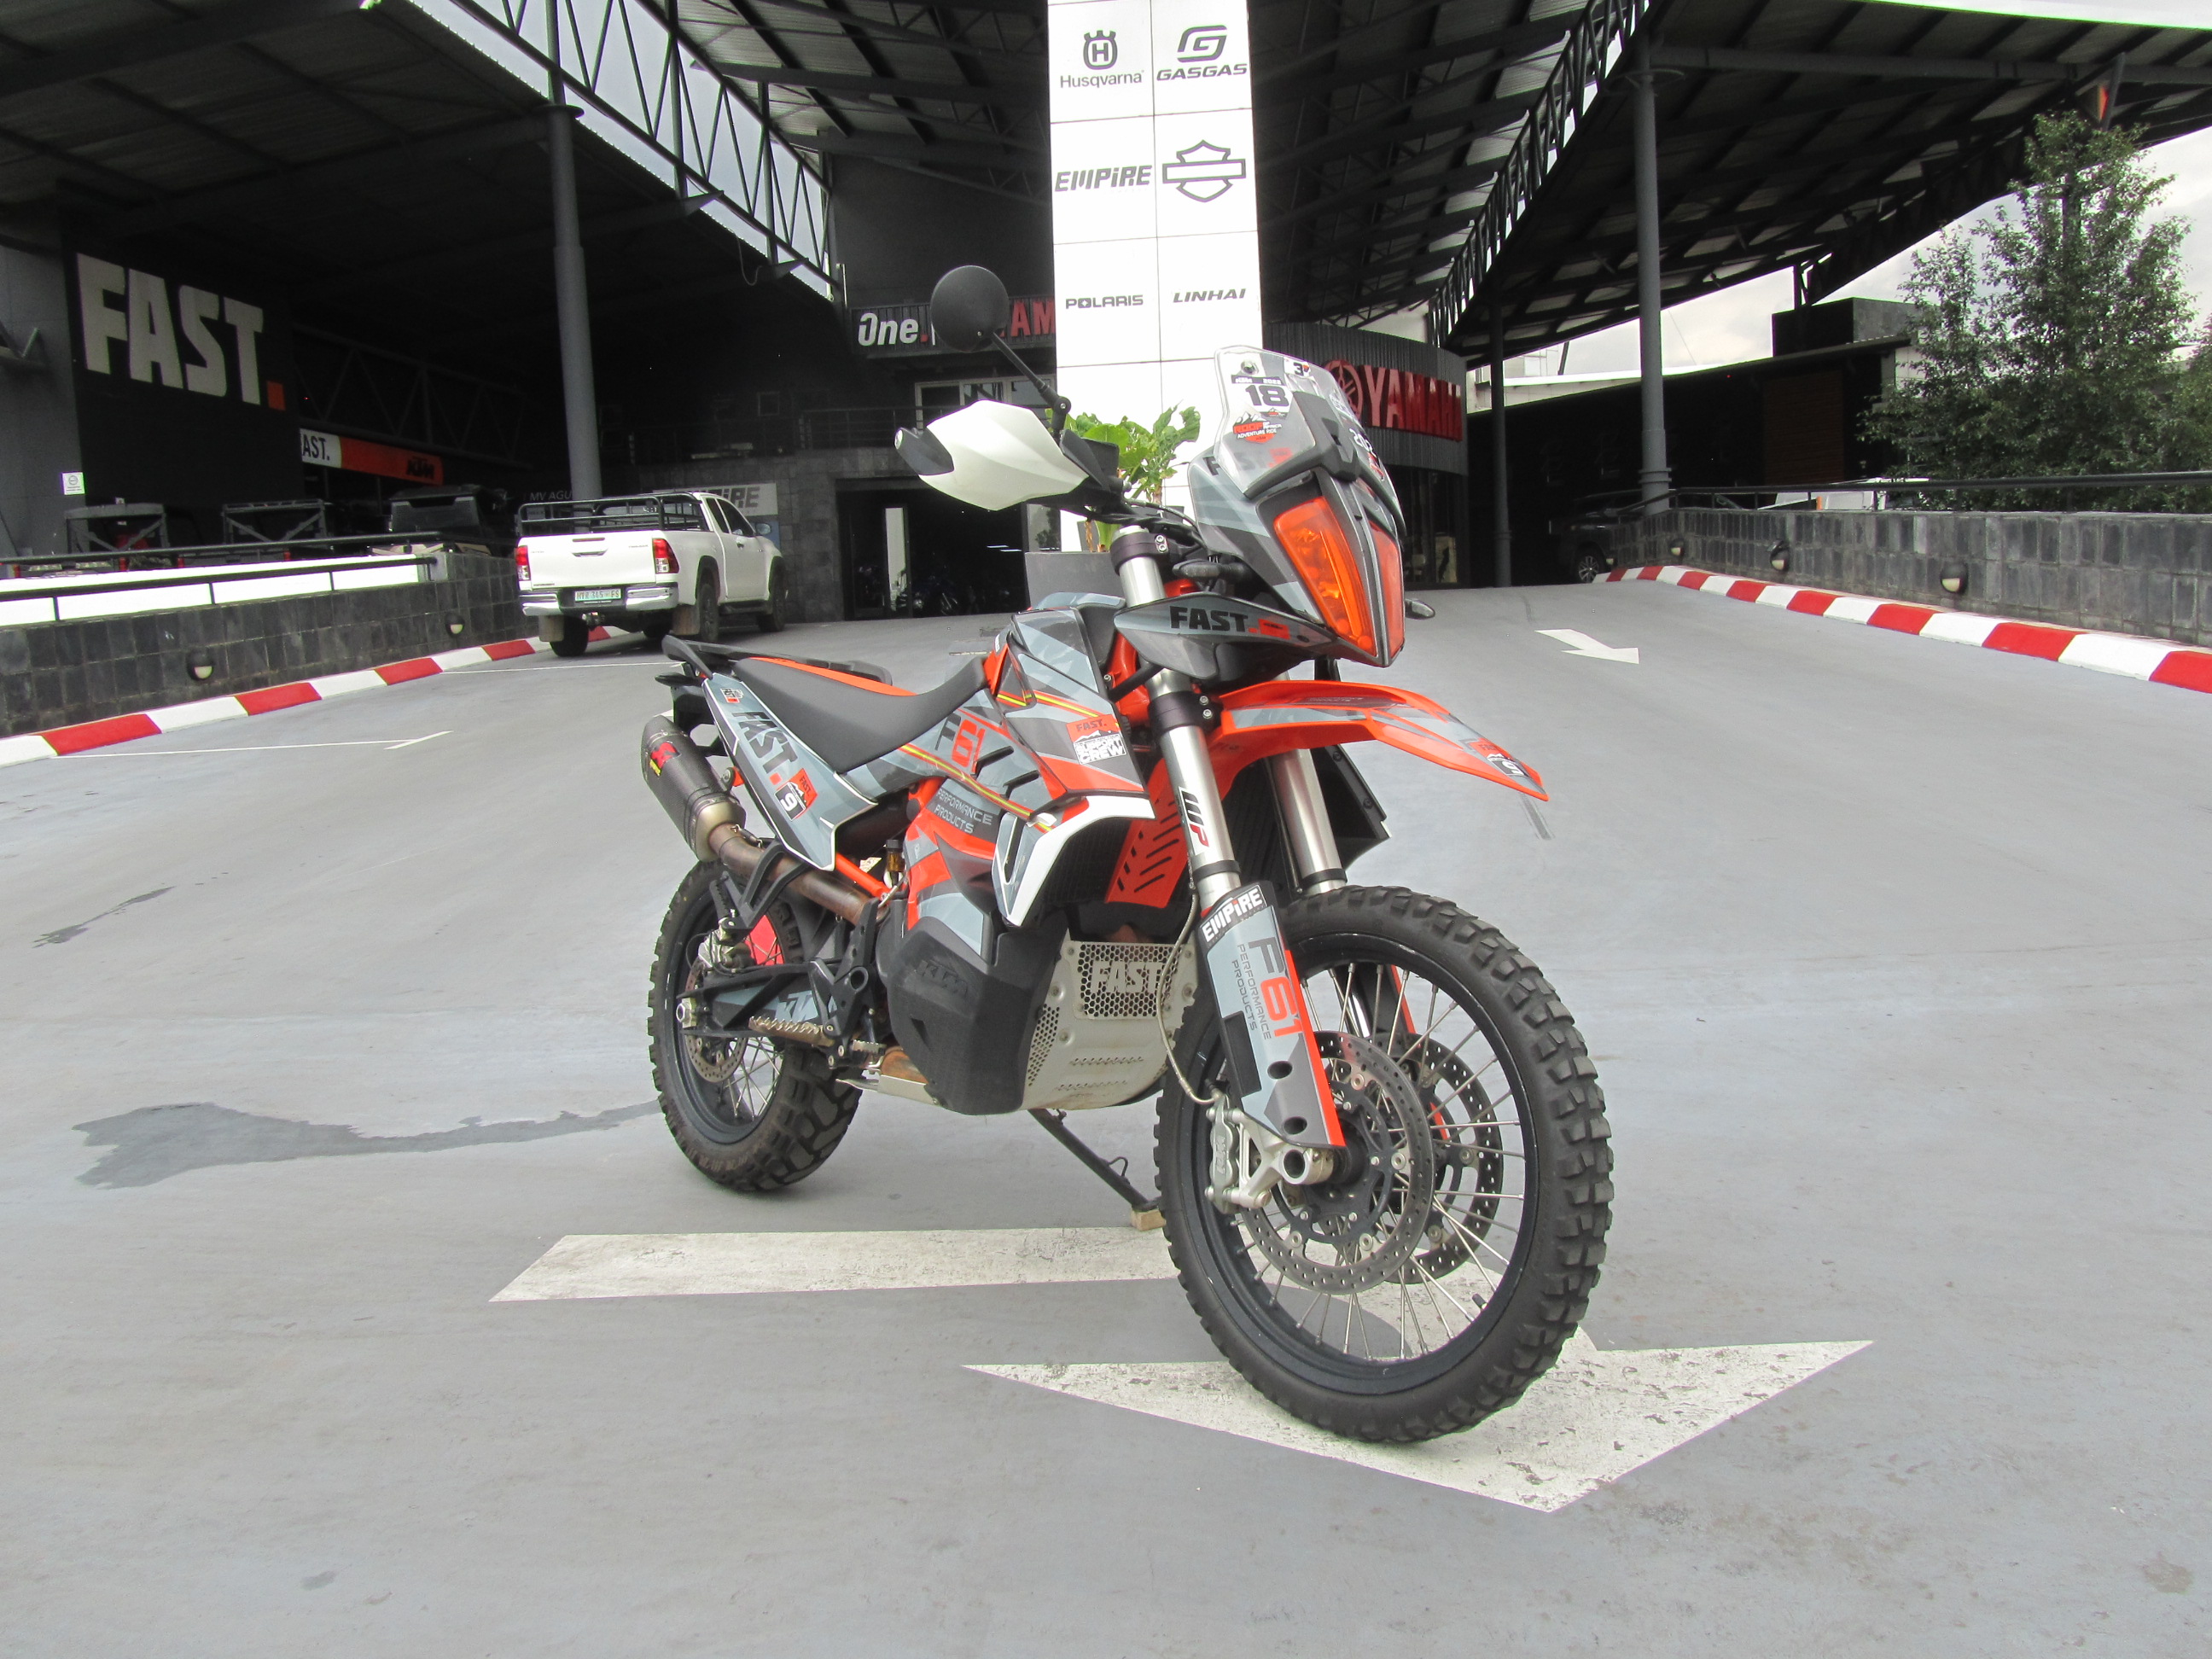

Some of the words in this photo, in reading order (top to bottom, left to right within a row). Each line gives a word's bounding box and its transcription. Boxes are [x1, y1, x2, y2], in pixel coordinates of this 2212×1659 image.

[1060, 72, 1142, 88] Husqvarna
[1156, 63, 1248, 81] GASGAS
[1066, 294, 1144, 309] POLARIS
[1173, 288, 1247, 303] LINHAI
[1245, 384, 1289, 407] 18
[1363, 364, 1464, 443] YAMAH
[1237, 428, 1266, 439] ADVENTURE
[300, 434, 330, 462] AST.
[530, 492, 546, 501] MV
[549, 491, 573, 500] AGU
[1076, 736, 1121, 754] SUPPORT
[1080, 745, 1124, 764] CREW
[936, 788, 993, 826] PERFORMANCE
[934, 804, 975, 835] PRODUCTS
[1231, 958, 1258, 1032] PRODUCTS
[1237, 943, 1272, 1040] PERFORMANCE
